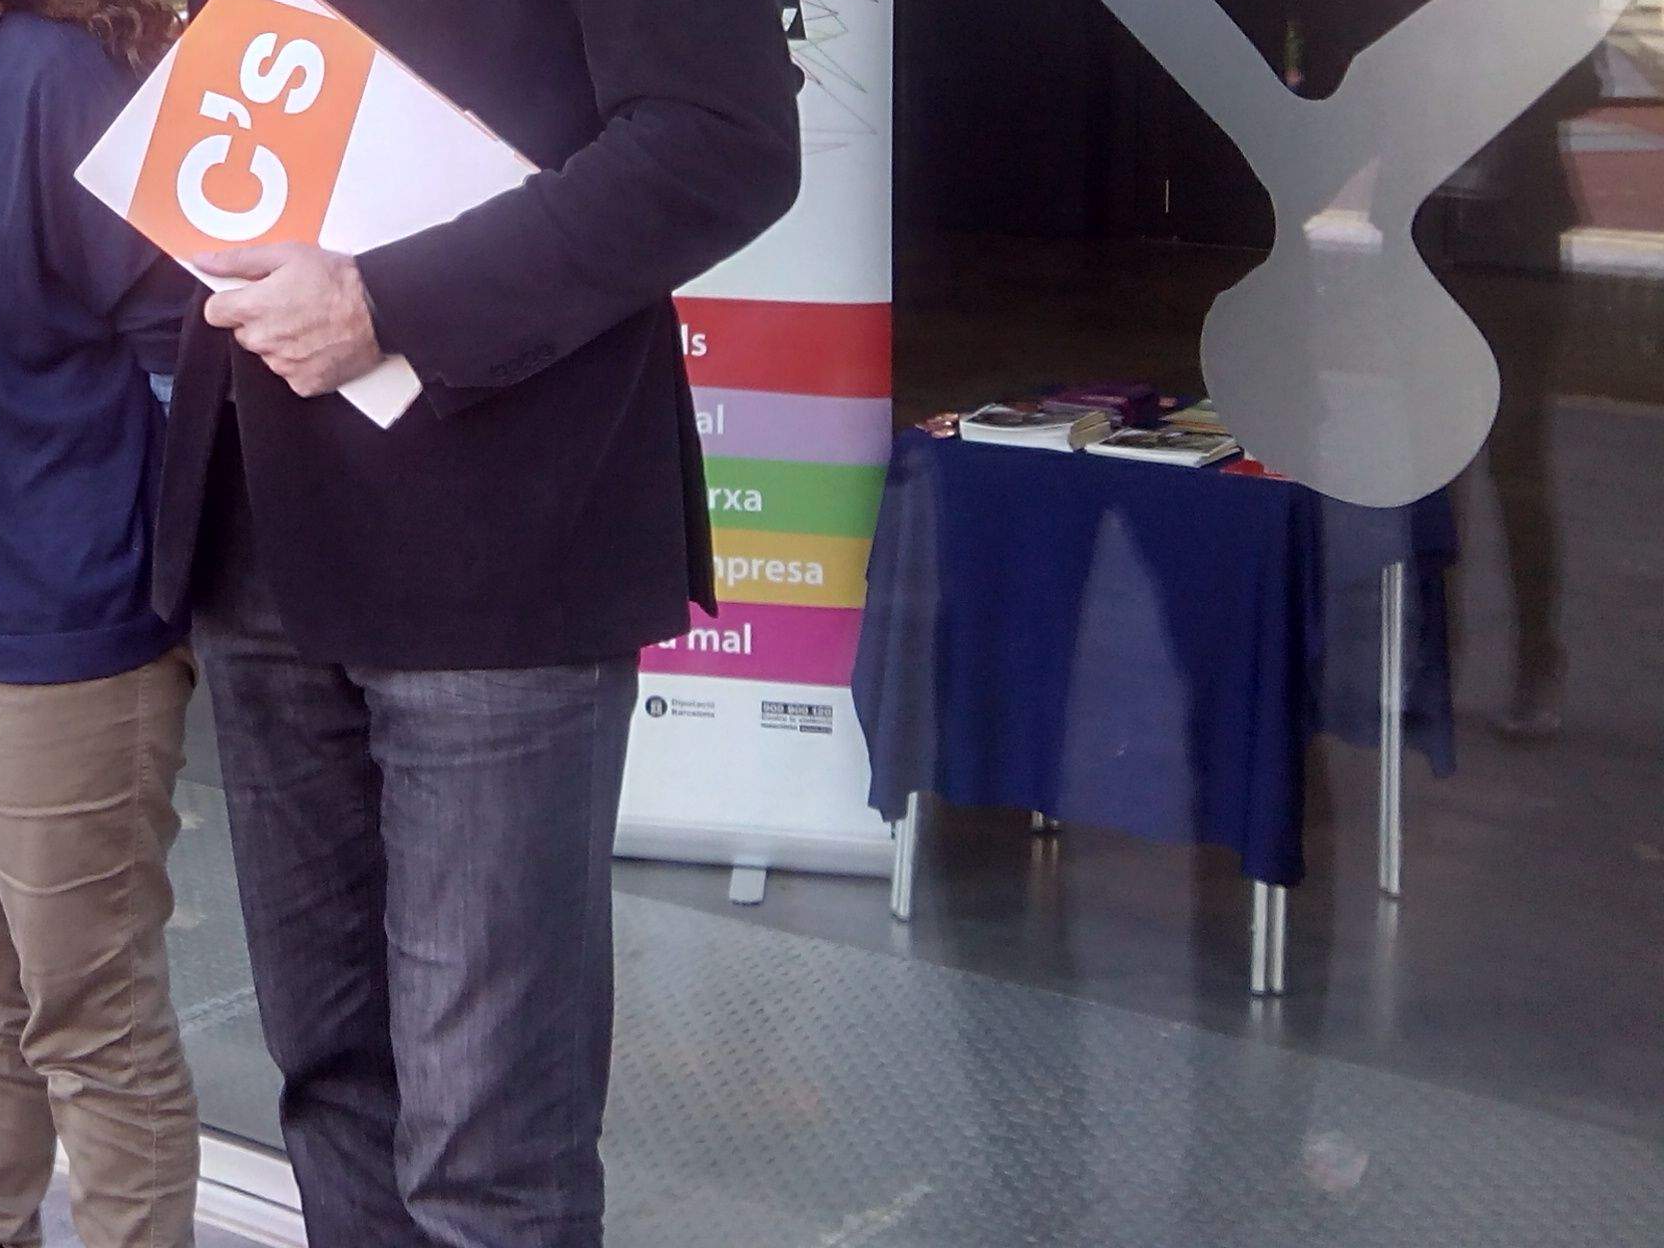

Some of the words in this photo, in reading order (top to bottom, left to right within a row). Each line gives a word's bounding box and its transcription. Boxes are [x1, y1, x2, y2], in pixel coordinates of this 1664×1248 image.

[177, 32, 325, 242] C's
[680, 323, 708, 357] ls
[697, 404, 725, 434] al
[708, 487, 763, 512] rxa
[687, 622, 753, 655] mal
